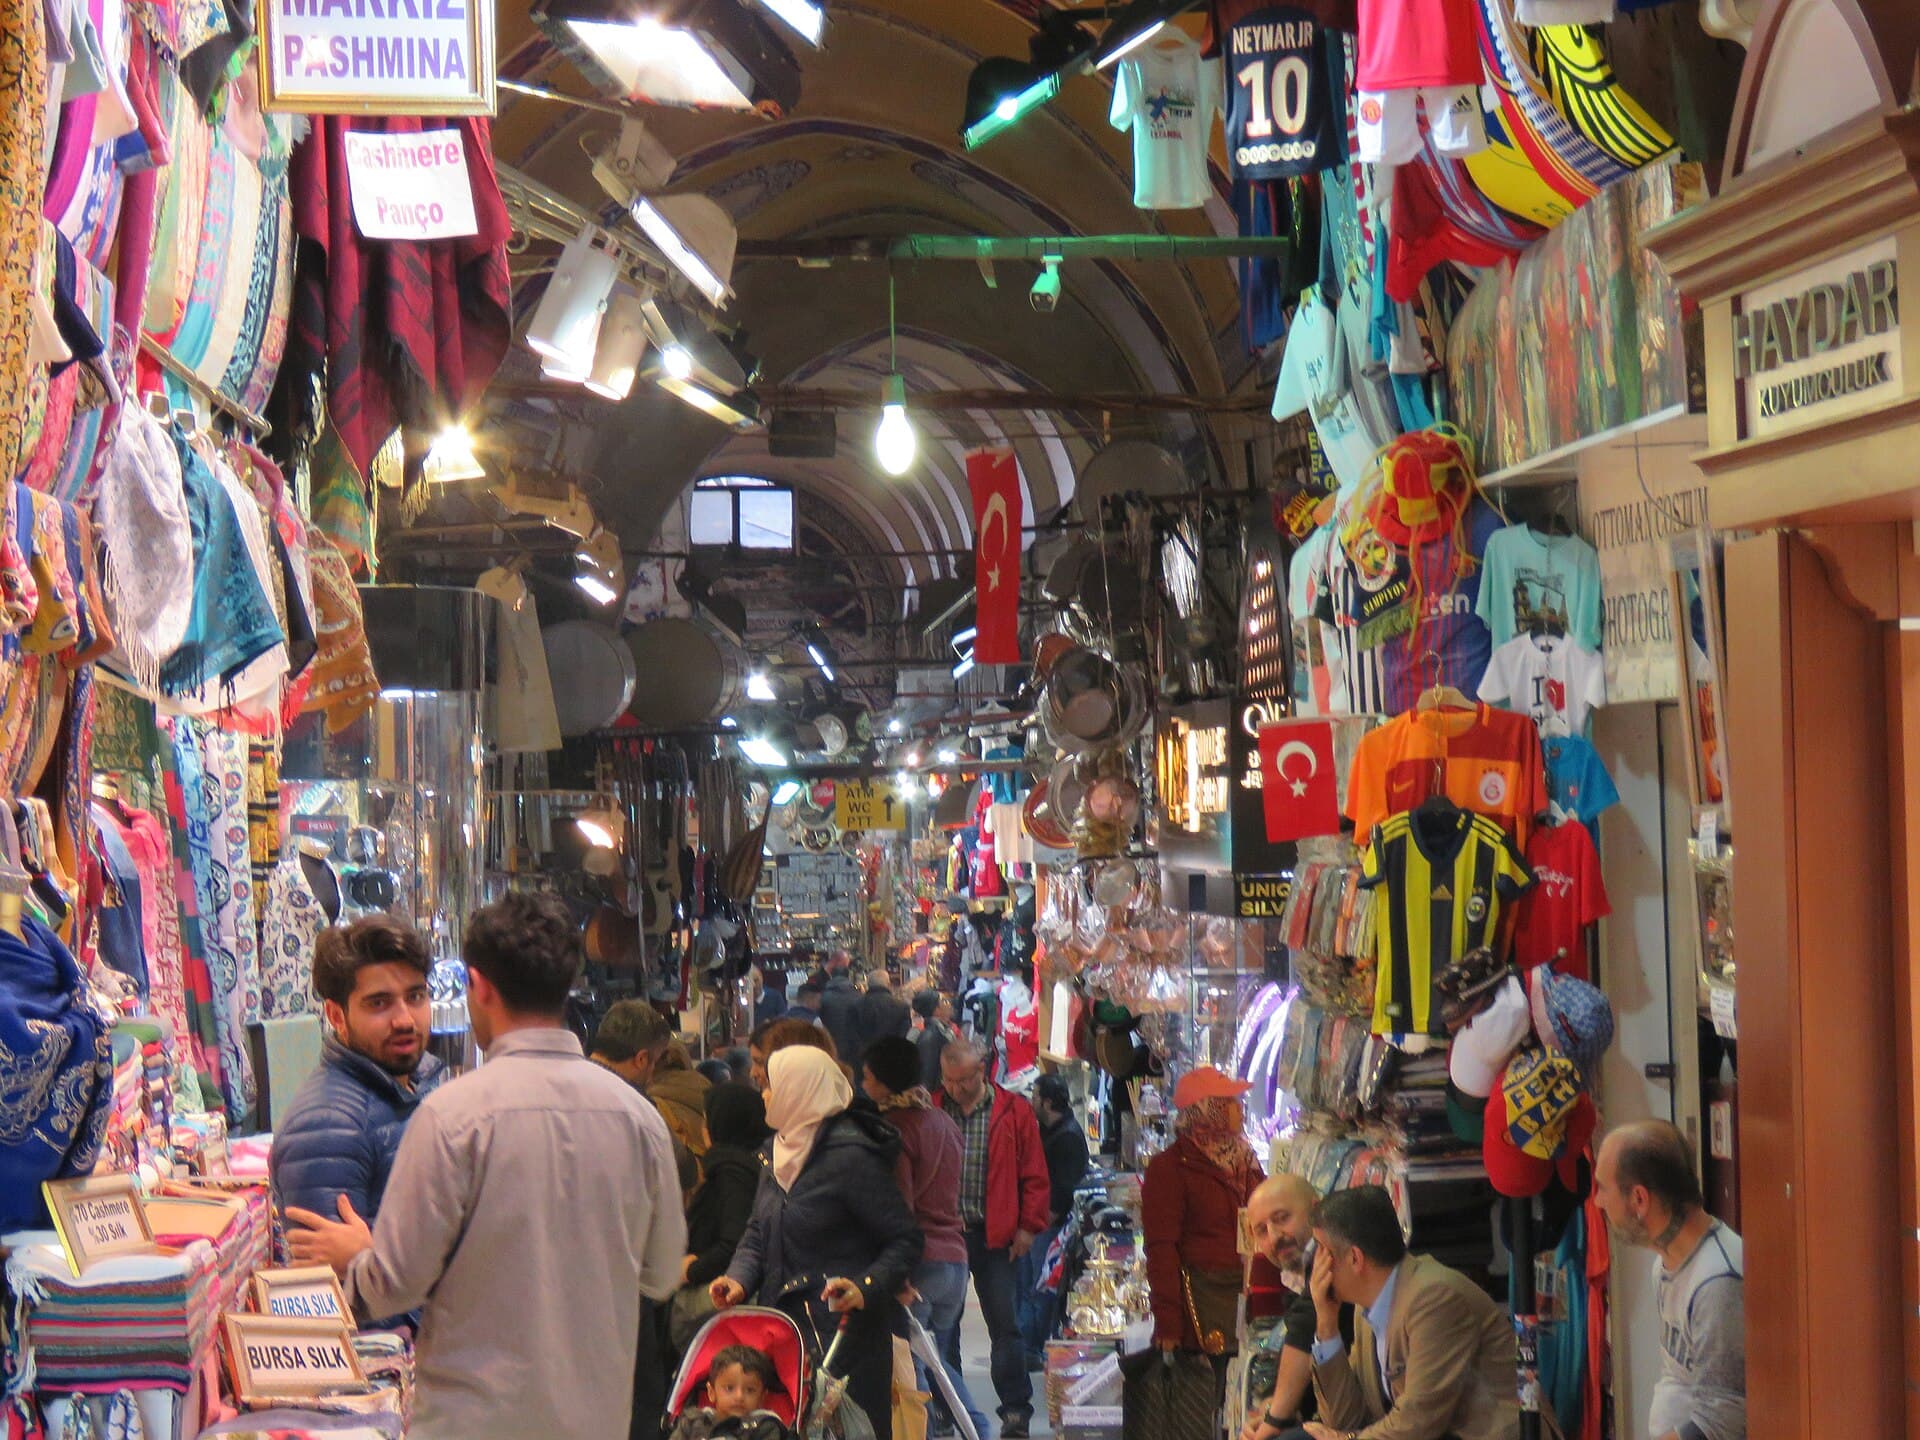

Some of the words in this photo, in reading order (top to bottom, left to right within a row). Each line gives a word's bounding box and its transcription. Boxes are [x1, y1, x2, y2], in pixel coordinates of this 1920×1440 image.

[1232, 22, 1296, 55] NEYMAR
[1298, 21, 1314, 48] JR
[1237, 56, 1309, 139] 10
[350, 137, 460, 170] Cashmere
[376, 197, 444, 233] Panço
[1733, 260, 1898, 378] HAYDAR
[1758, 353, 1886, 418] KUYUMCULUK
[1592, 500, 1653, 549] OTTOMAN
[1532, 676, 1545, 707] I
[846, 787, 874, 799] ATM
[848, 801, 871, 813] WC
[847, 815, 872, 828] PTT
[87, 1200, 130, 1221] Cashmere
[108, 1222, 128, 1240] Silk
[271, 1296, 312, 1317] BURSA
[310, 1293, 339, 1315] SILK
[247, 1346, 307, 1370] BURSA
[307, 1346, 348, 1369] SILK
